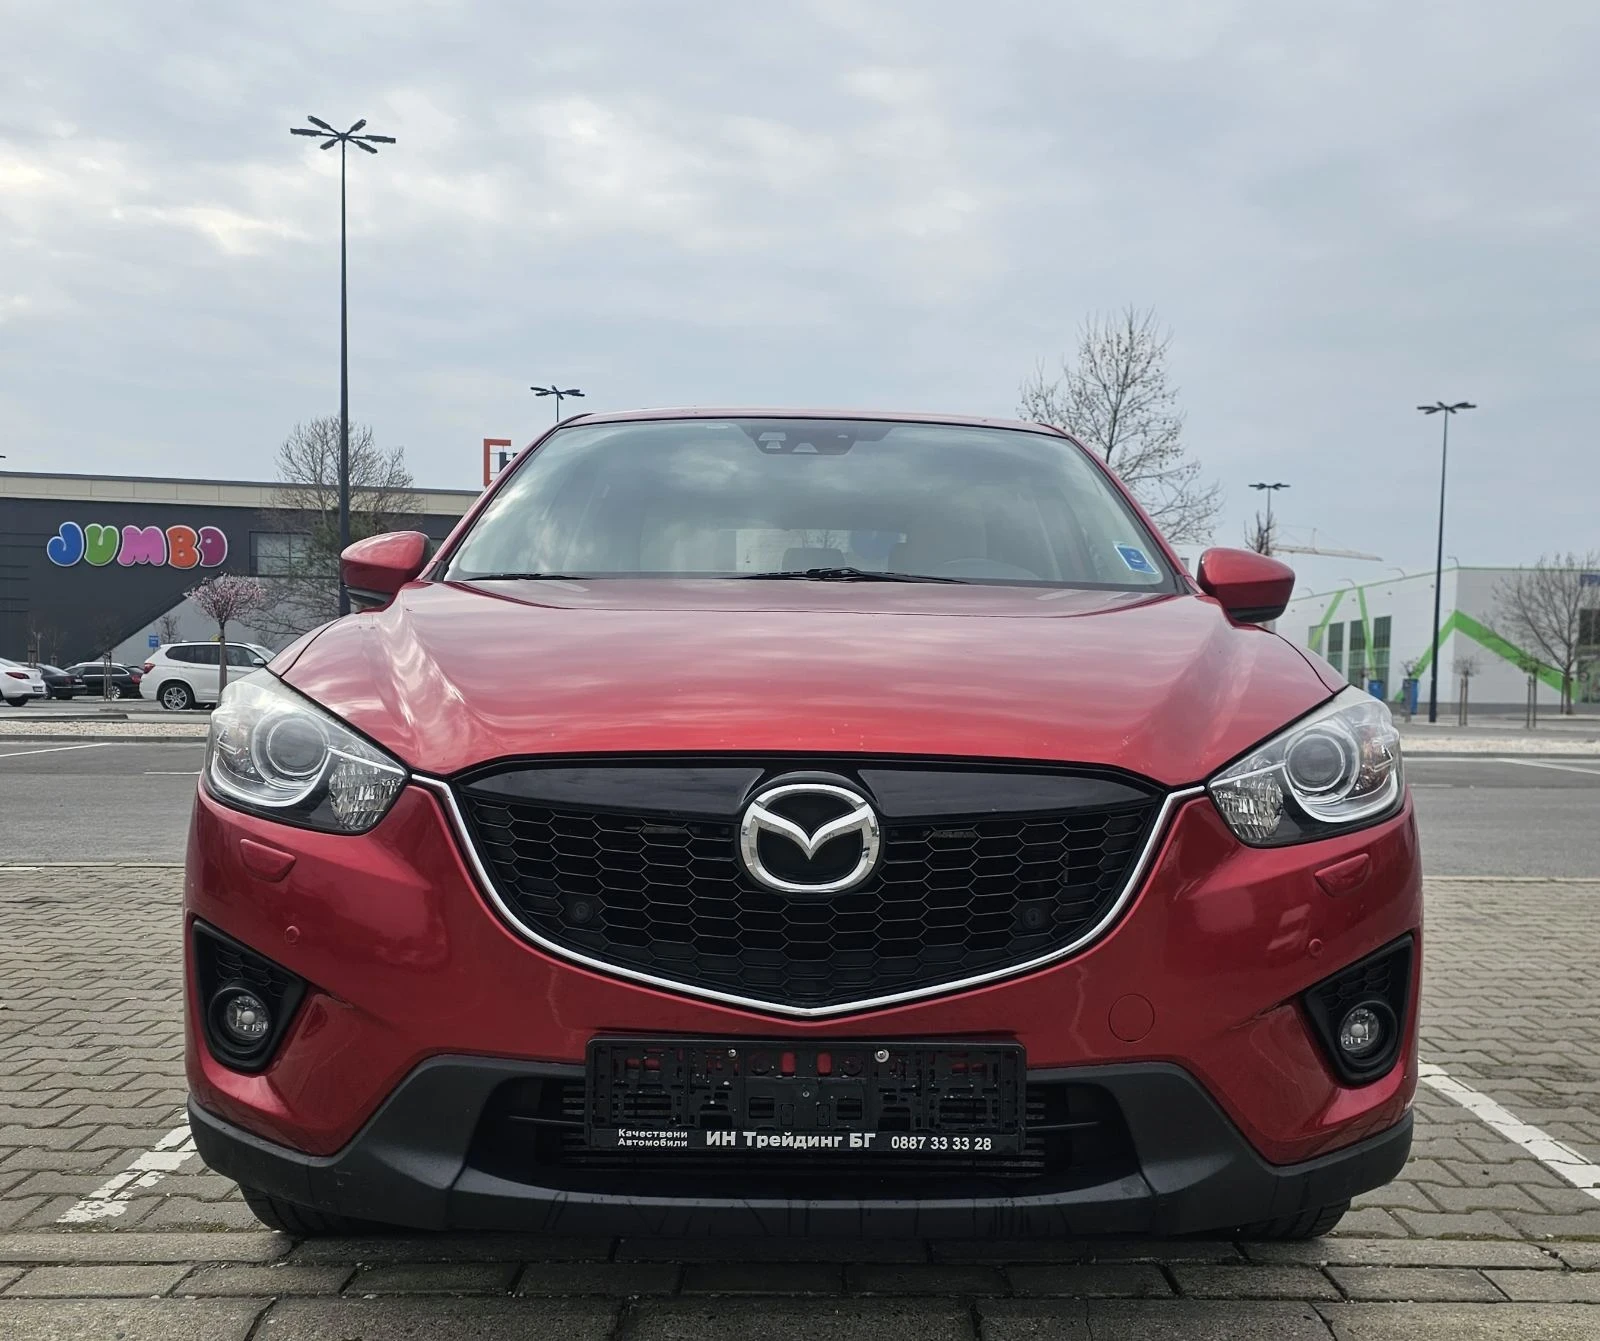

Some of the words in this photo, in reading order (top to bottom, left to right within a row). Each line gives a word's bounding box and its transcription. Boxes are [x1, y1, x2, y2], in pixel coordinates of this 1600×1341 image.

[47, 521, 228, 569] JUMBO
[618, 1128, 688, 1138] Качествени
[617, 1138, 688, 1147] Автомобили
[706, 1131, 736, 1146] ИН
[743, 1132, 843, 1149] Трейдинг
[849, 1133, 876, 1147] БГ
[891, 1136, 926, 1149] 0887
[930, 1137, 948, 1149] 33
[952, 1137, 970, 1150] 33
[974, 1138, 992, 1150] 28
